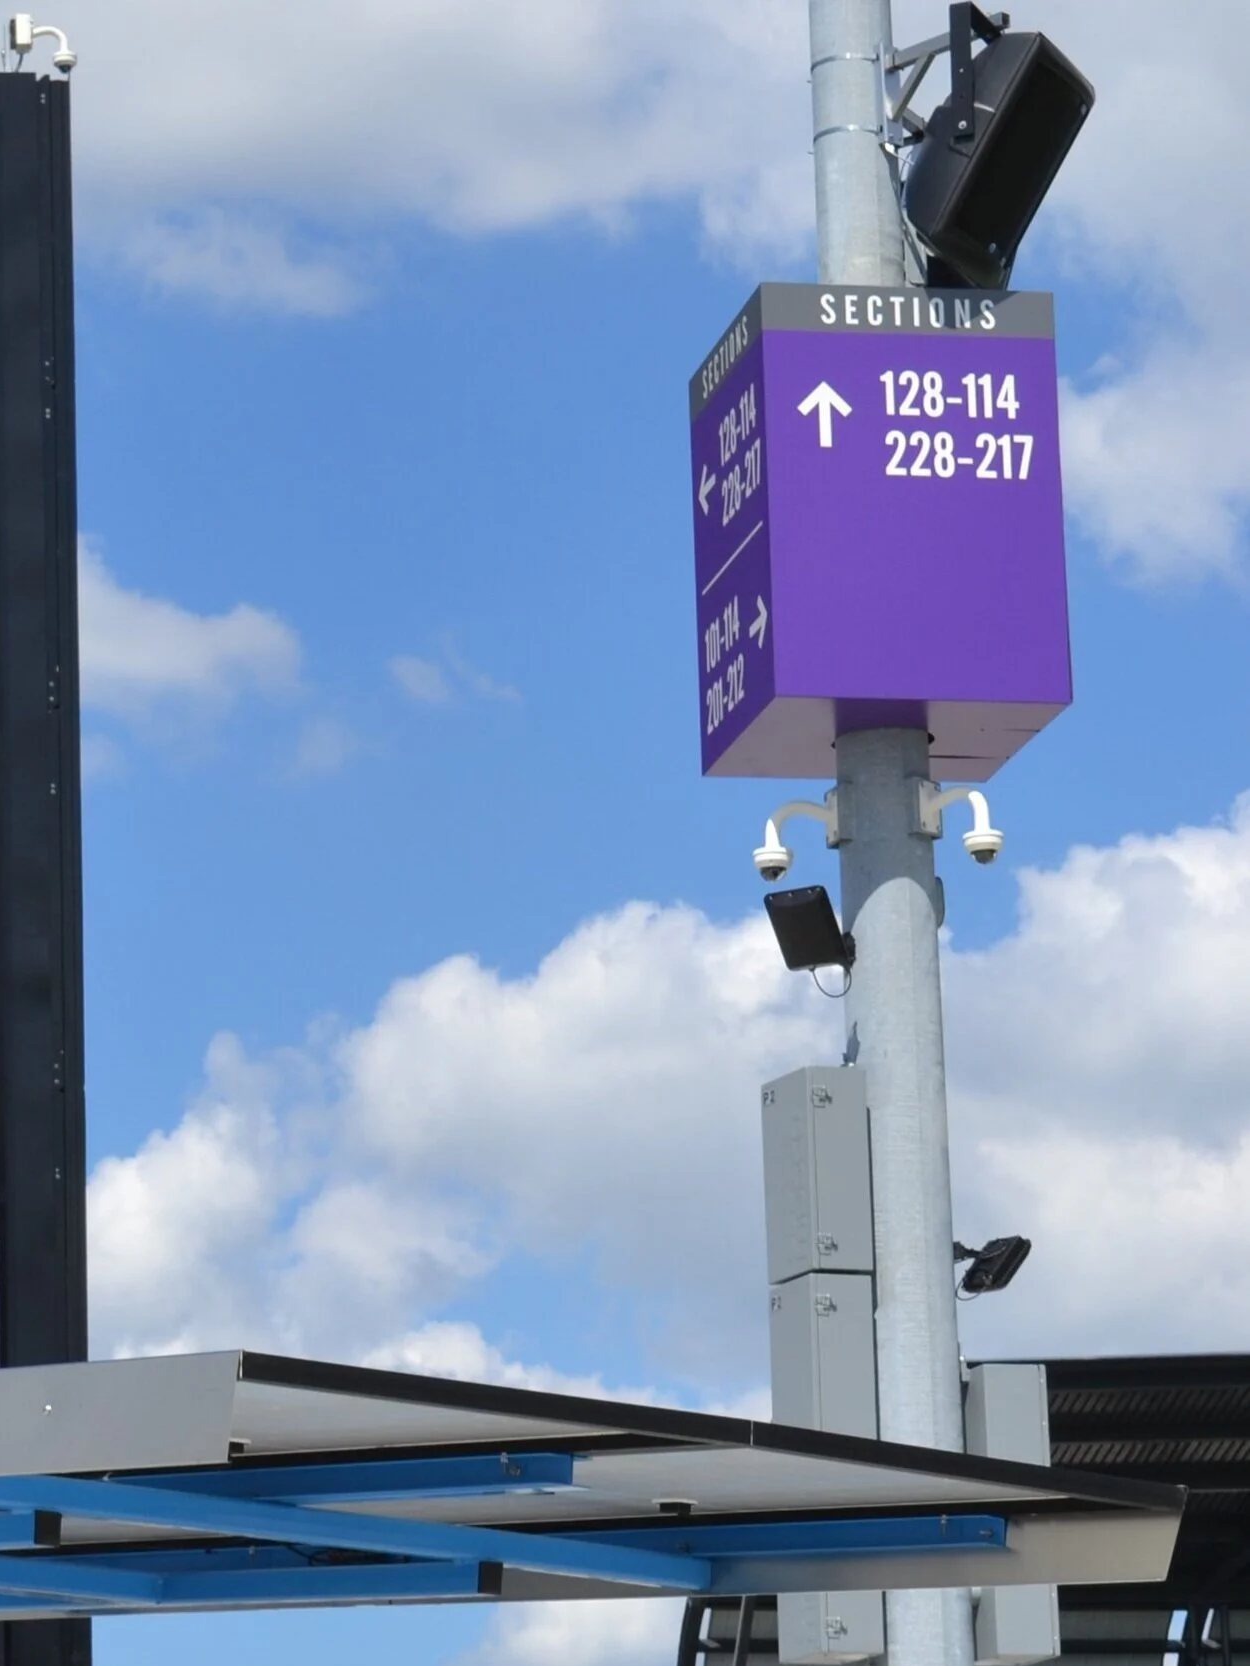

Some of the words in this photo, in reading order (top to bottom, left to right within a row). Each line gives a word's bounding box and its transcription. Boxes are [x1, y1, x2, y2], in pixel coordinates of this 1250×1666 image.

[820, 293, 996, 330] SECTIONS
[702, 315, 748, 399] SECTIONS
[879, 370, 1020, 419] 128-114
[718, 382, 757, 467] 128-114
[885, 429, 1034, 480] 228-217
[721, 437, 761, 527] 228-217
[704, 594, 740, 673] 101-114
[706, 652, 745, 735] 201-212
